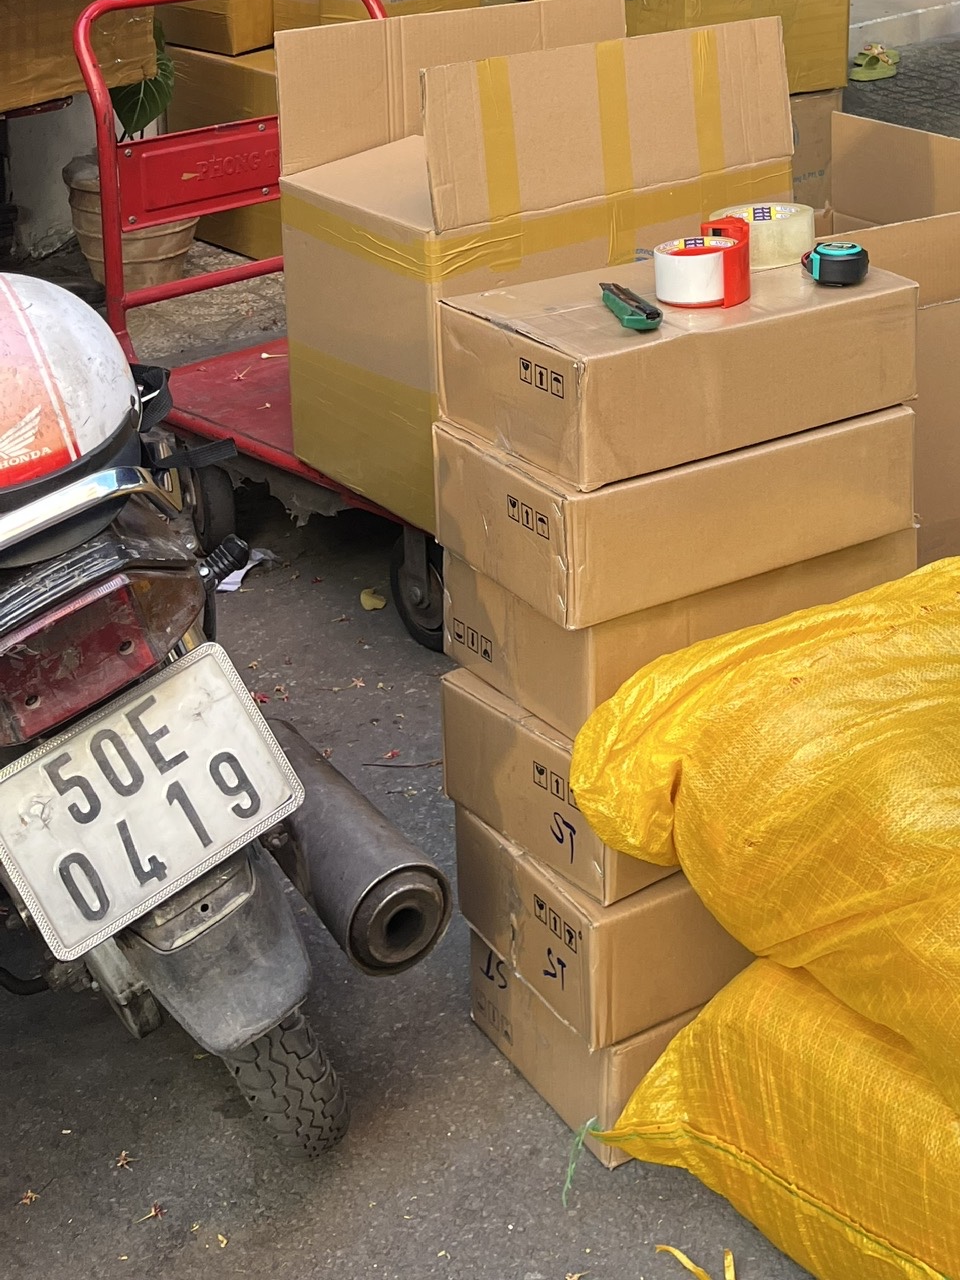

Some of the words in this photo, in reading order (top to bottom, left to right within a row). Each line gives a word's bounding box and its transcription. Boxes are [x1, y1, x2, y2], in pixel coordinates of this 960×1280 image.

[0, 447, 53, 470] HONDA
[43, 694, 189, 825] 50E
[59, 752, 261, 921] 0419
